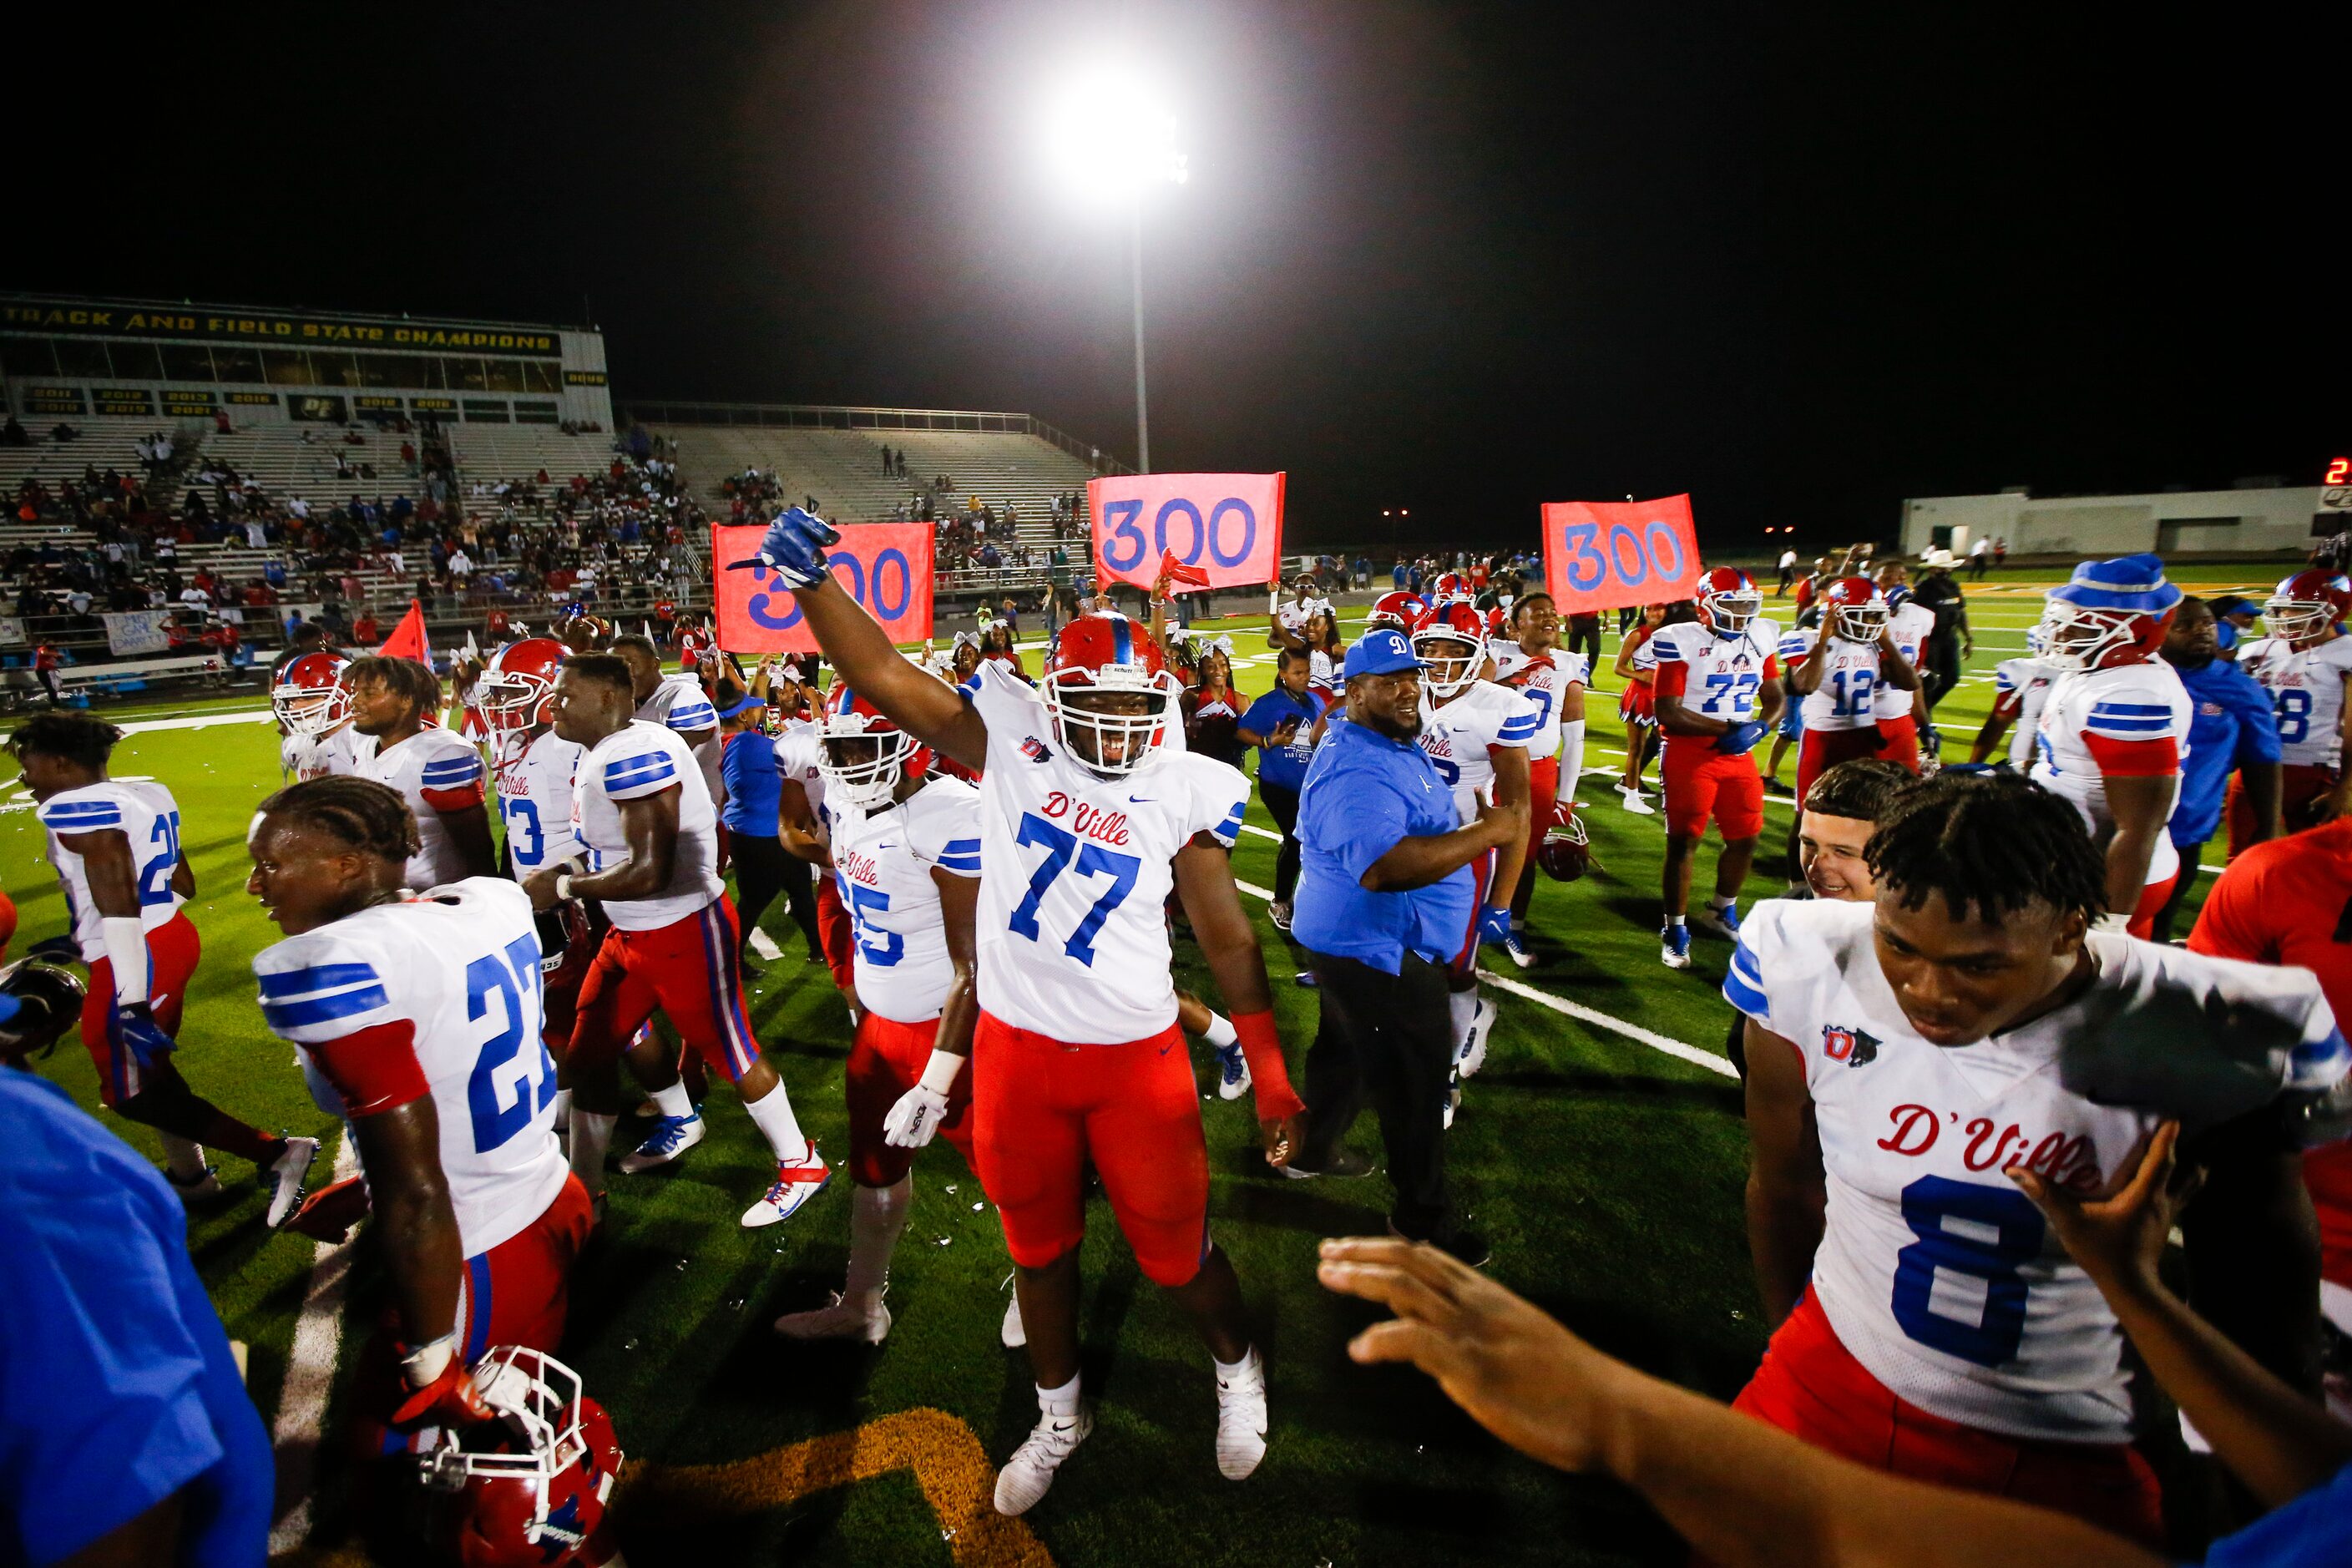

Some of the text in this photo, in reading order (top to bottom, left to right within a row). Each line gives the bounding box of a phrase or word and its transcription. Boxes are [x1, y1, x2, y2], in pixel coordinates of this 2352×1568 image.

[124, 312, 197, 331] AND
[209, 317, 291, 335] FIELD
[302, 323, 384, 341] STATE
[393, 328, 551, 351] CHAMPIONS
[2324, 458, 2348, 484] 2
[1103, 498, 1257, 572] 300
[1565, 521, 1684, 592] 300
[1702, 673, 1759, 713] 72
[1832, 670, 1874, 716] 12
[2265, 688, 2313, 744] 8
[1041, 790, 1129, 847] D'Ville
[1008, 811, 1141, 969] 77
[467, 931, 558, 1154] 27
[1876, 1103, 2105, 1192] D'Ville
[1891, 1173, 2046, 1368] 8
